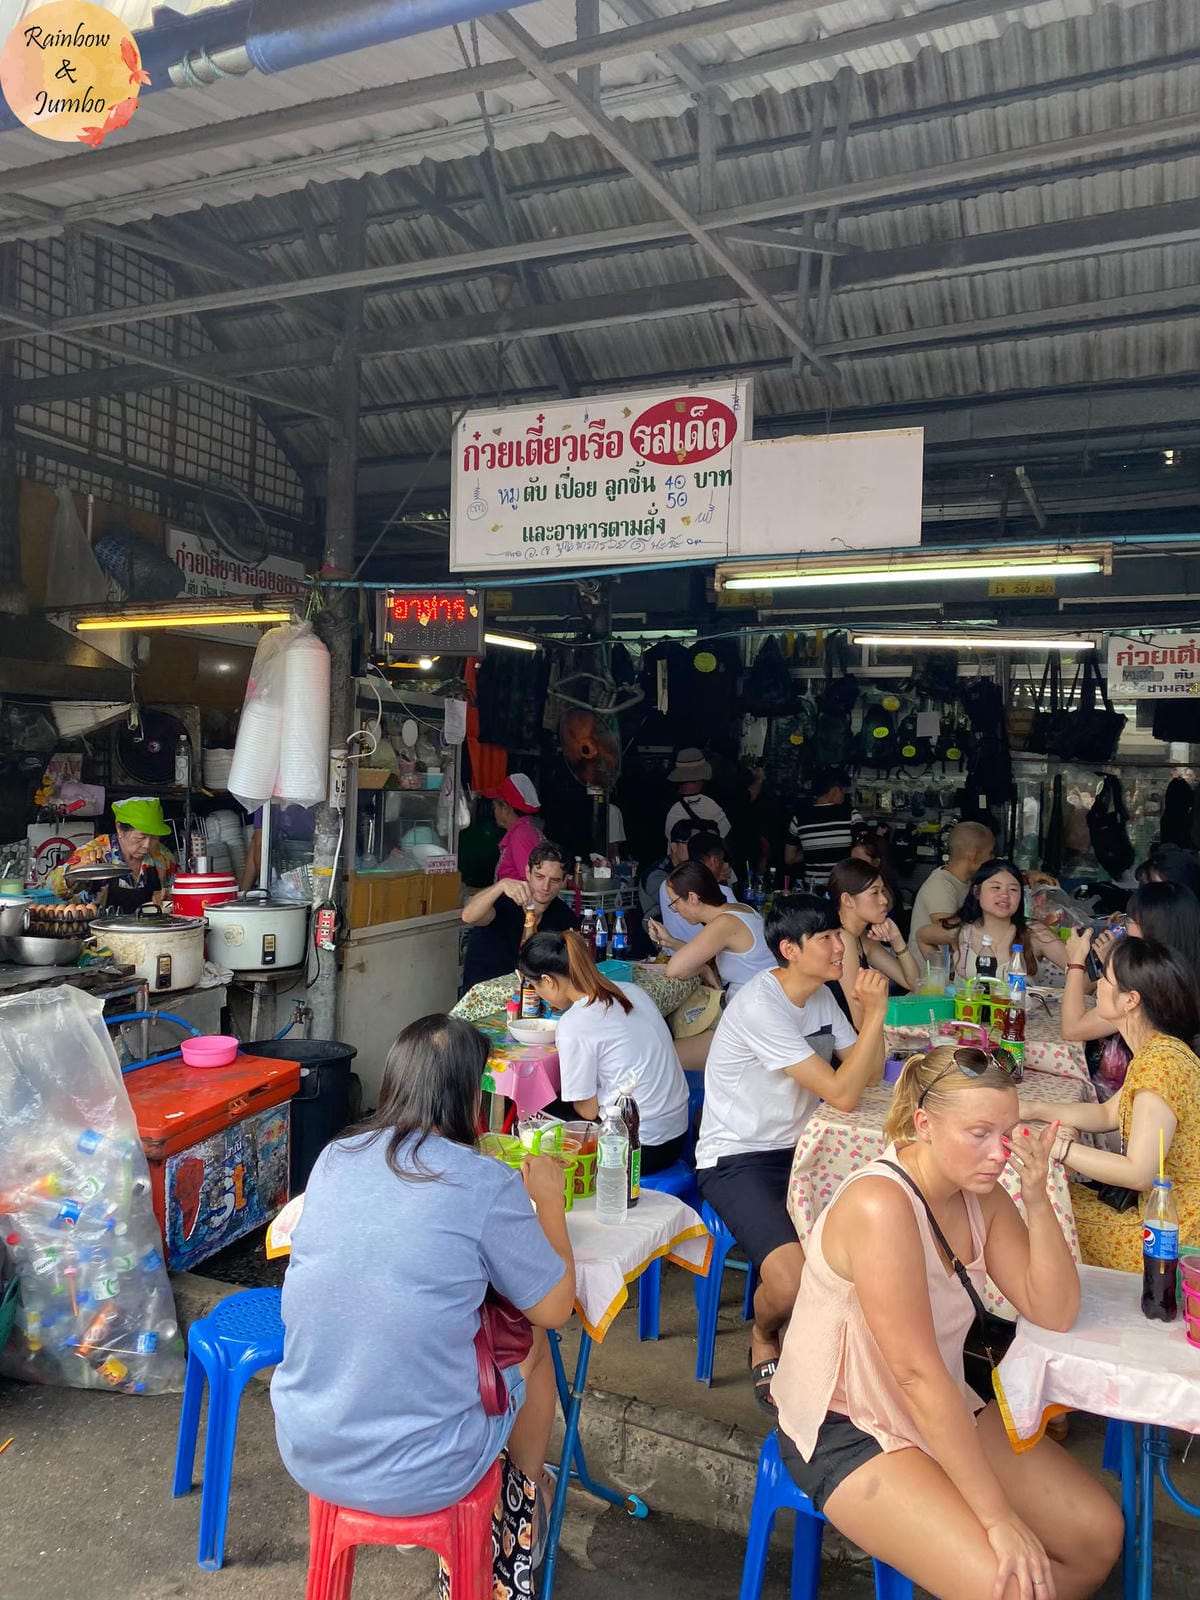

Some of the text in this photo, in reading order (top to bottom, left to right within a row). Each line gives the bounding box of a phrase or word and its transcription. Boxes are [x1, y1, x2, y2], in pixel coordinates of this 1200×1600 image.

[463, 404, 726, 472] ก๋วยเตี๋ยวเรือ รสเด็ด
[523, 476, 547, 502] ตับ
[555, 466, 597, 499] เปื่อย
[605, 460, 656, 501] ลูกชิ้น
[664, 474, 687, 490] 40
[693, 468, 733, 489] บาท
[666, 492, 688, 509] 50
[522, 502, 666, 543] และอาหารตามสั่ง
